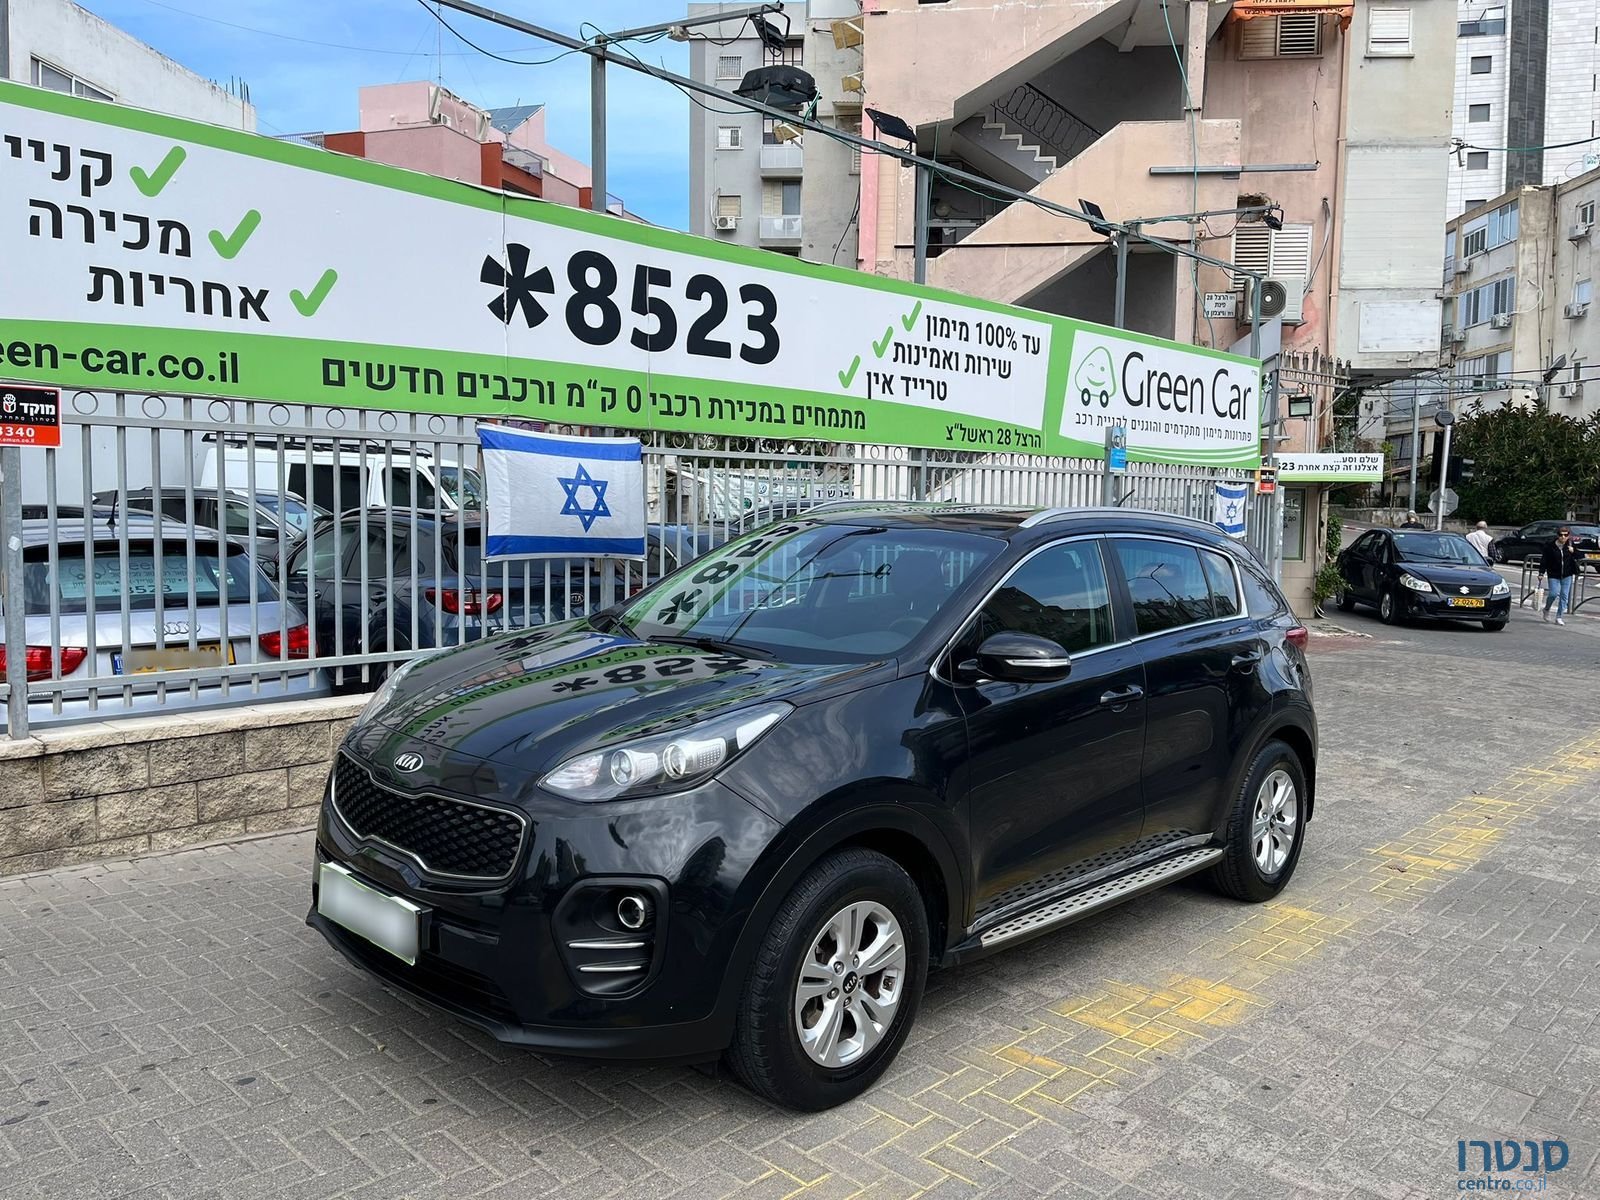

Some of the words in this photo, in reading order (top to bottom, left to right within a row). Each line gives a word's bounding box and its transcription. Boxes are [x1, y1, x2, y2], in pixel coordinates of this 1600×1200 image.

[28, 198, 192, 258] מכירה
[87, 265, 271, 323] אחריות
[926, 314, 969, 342] מימון
[975, 321, 1018, 351] 100%
[893, 341, 960, 372] ואמינות
[1022, 334, 1041, 356] עד
[0, 340, 239, 384] en-car.co.il
[964, 353, 1012, 379] שירות
[322, 357, 444, 396] חדשים
[457, 371, 555, 405] ורכבים
[866, 371, 895, 400] אין
[901, 375, 948, 401] טרייד
[1122, 351, 1205, 415] Green
[1211, 368, 1252, 421] Car
[19, 402, 56, 416] מוקד
[626, 385, 642, 413] 0
[649, 392, 701, 418] רכבי
[708, 397, 786, 424] במכירת
[792, 404, 866, 430] מתמחים
[1075, 412, 1093, 425] רכב
[1096, 413, 1128, 427] לקניית
[1131, 419, 1162, 433] והוגנים
[997, 428, 1012, 445] 28
[1015, 428, 1042, 449] הרצל
[1164, 422, 1200, 438] מתקדמים
[1203, 426, 1222, 440] מימון
[1224, 429, 1252, 442] פתרונות
[1297, 464, 1321, 472] אחרת
[1322, 464, 1341, 473] קצת
[1354, 463, 1378, 472] אצלנו
[1359, 455, 1379, 463] שלם
[395, 753, 419, 770] KIA
[844, 974, 858, 992] KIA
